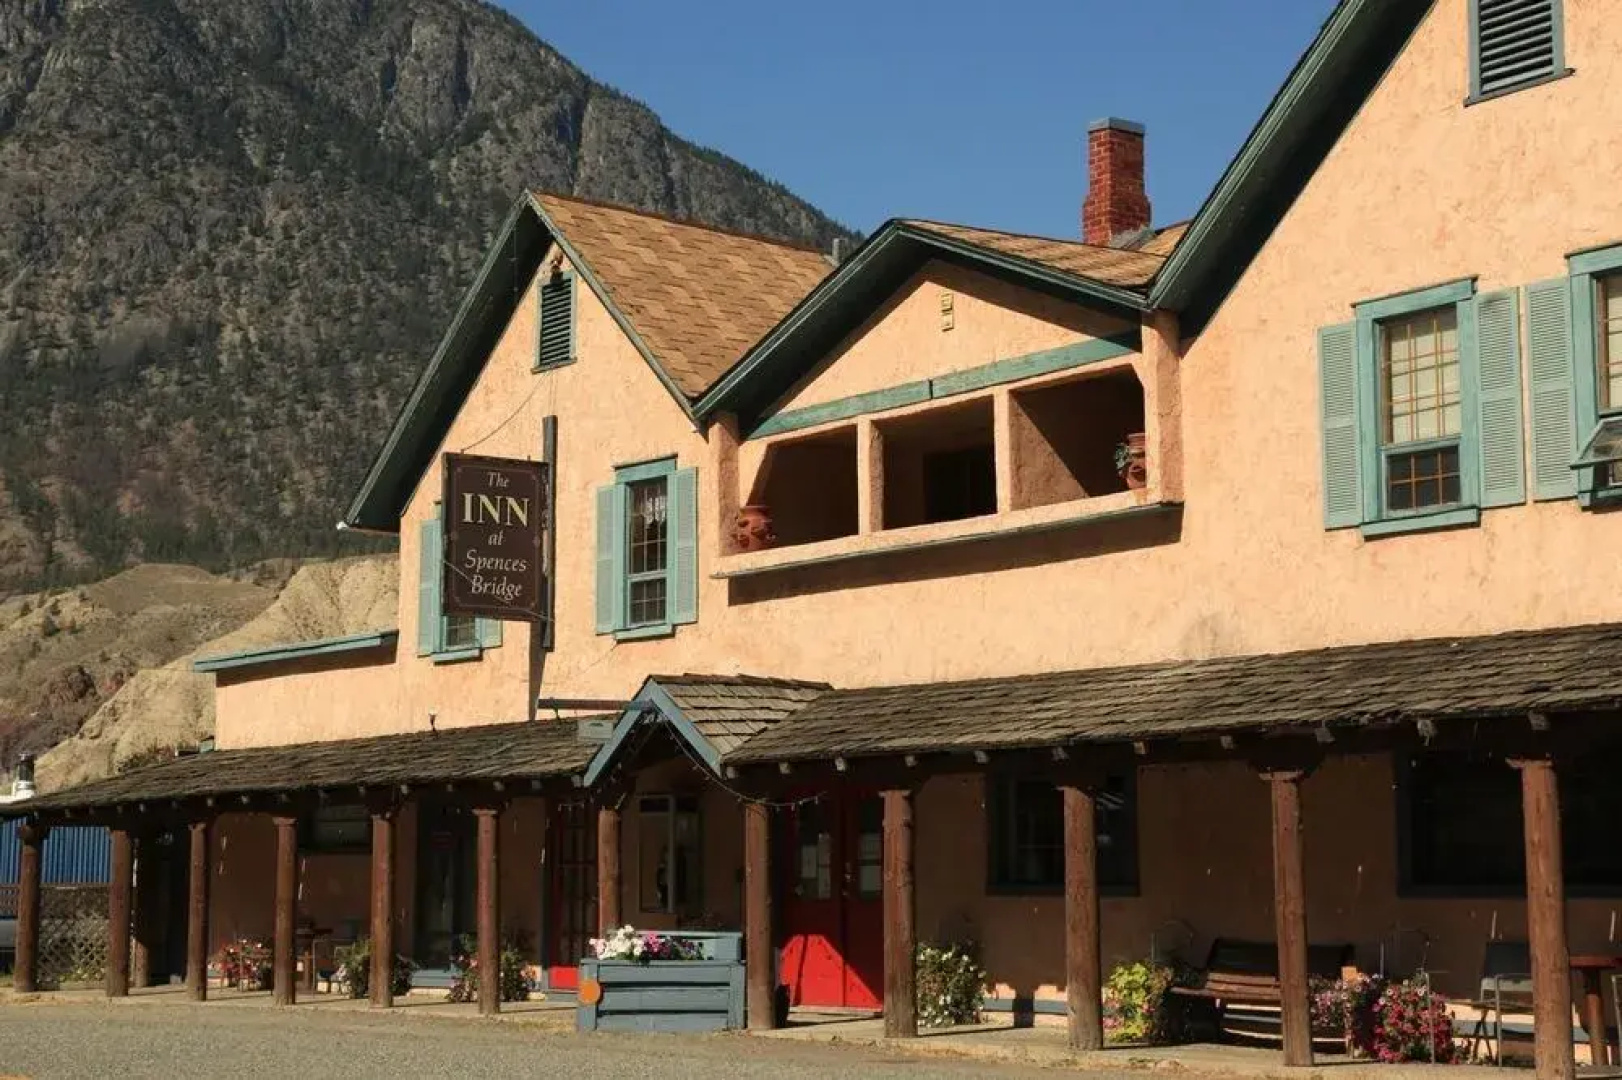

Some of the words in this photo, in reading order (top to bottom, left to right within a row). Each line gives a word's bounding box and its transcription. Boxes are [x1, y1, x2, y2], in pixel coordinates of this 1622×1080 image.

[487, 472, 510, 488] The
[462, 492, 530, 527] INN
[488, 530, 504, 546] at
[465, 549, 527, 573] Spences
[471, 574, 523, 601] Bridge
